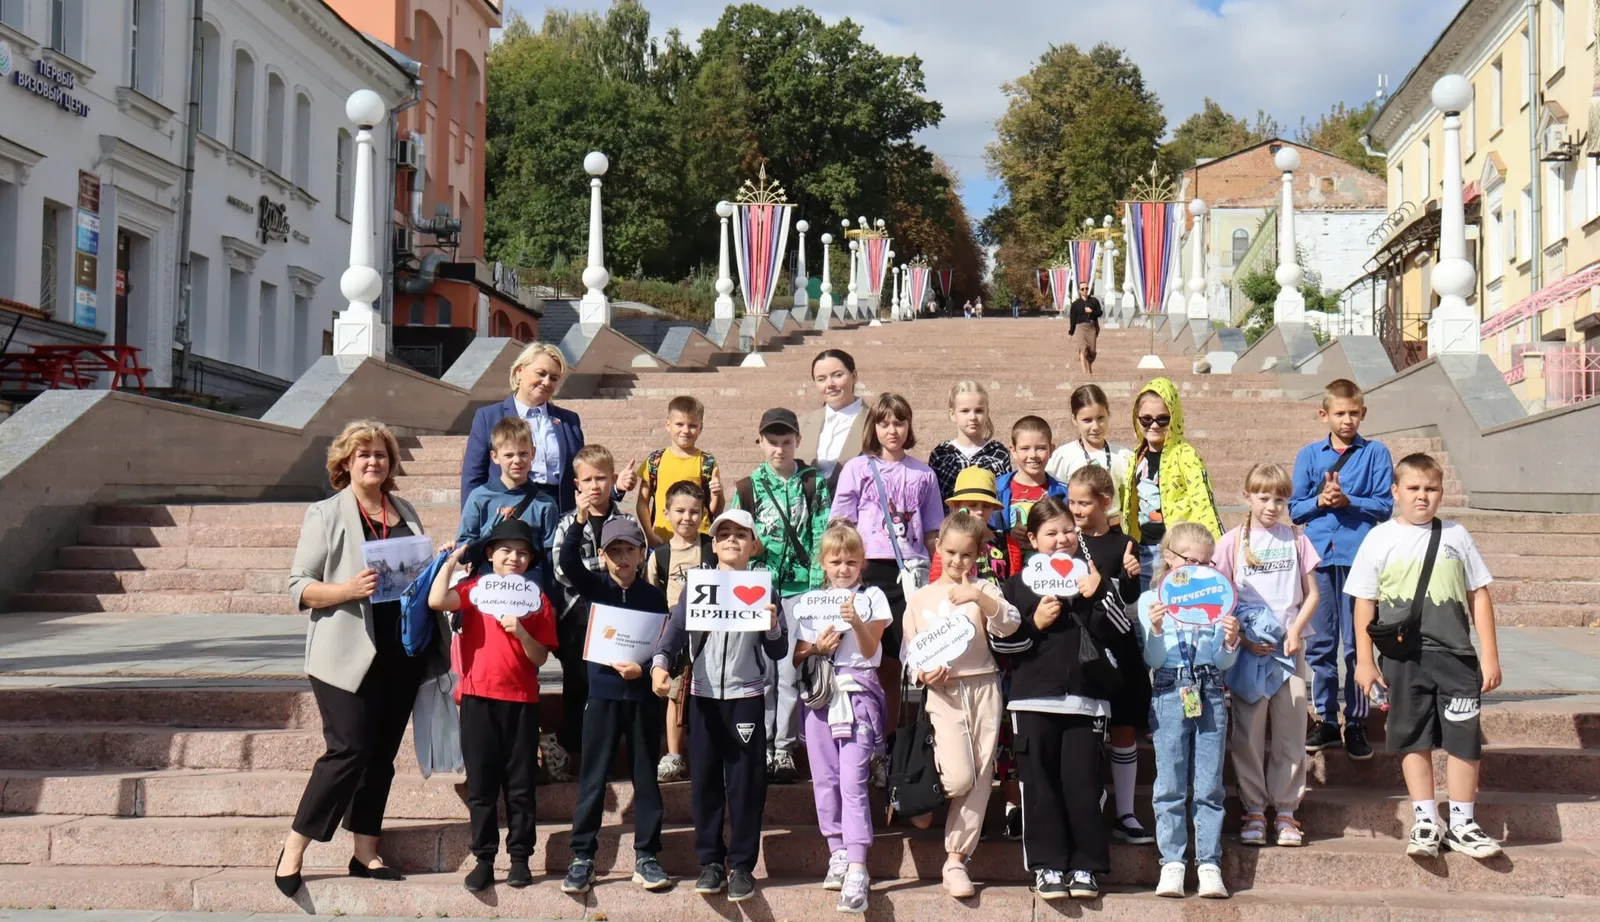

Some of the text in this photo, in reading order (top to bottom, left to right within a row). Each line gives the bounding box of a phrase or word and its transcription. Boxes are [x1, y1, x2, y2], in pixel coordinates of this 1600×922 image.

[38, 60, 76, 90] ПЕРВЫЙ
[17, 72, 64, 107] ВИЗОВЫЙ
[1034, 561, 1043, 572] Я
[485, 580, 533, 592] БРЯНСК
[690, 584, 721, 606] Я
[1170, 584, 1225, 605] ОТЕЧЕСТВО
[689, 608, 764, 620] БРЯНСК
[1448, 697, 1479, 712] NIKE
